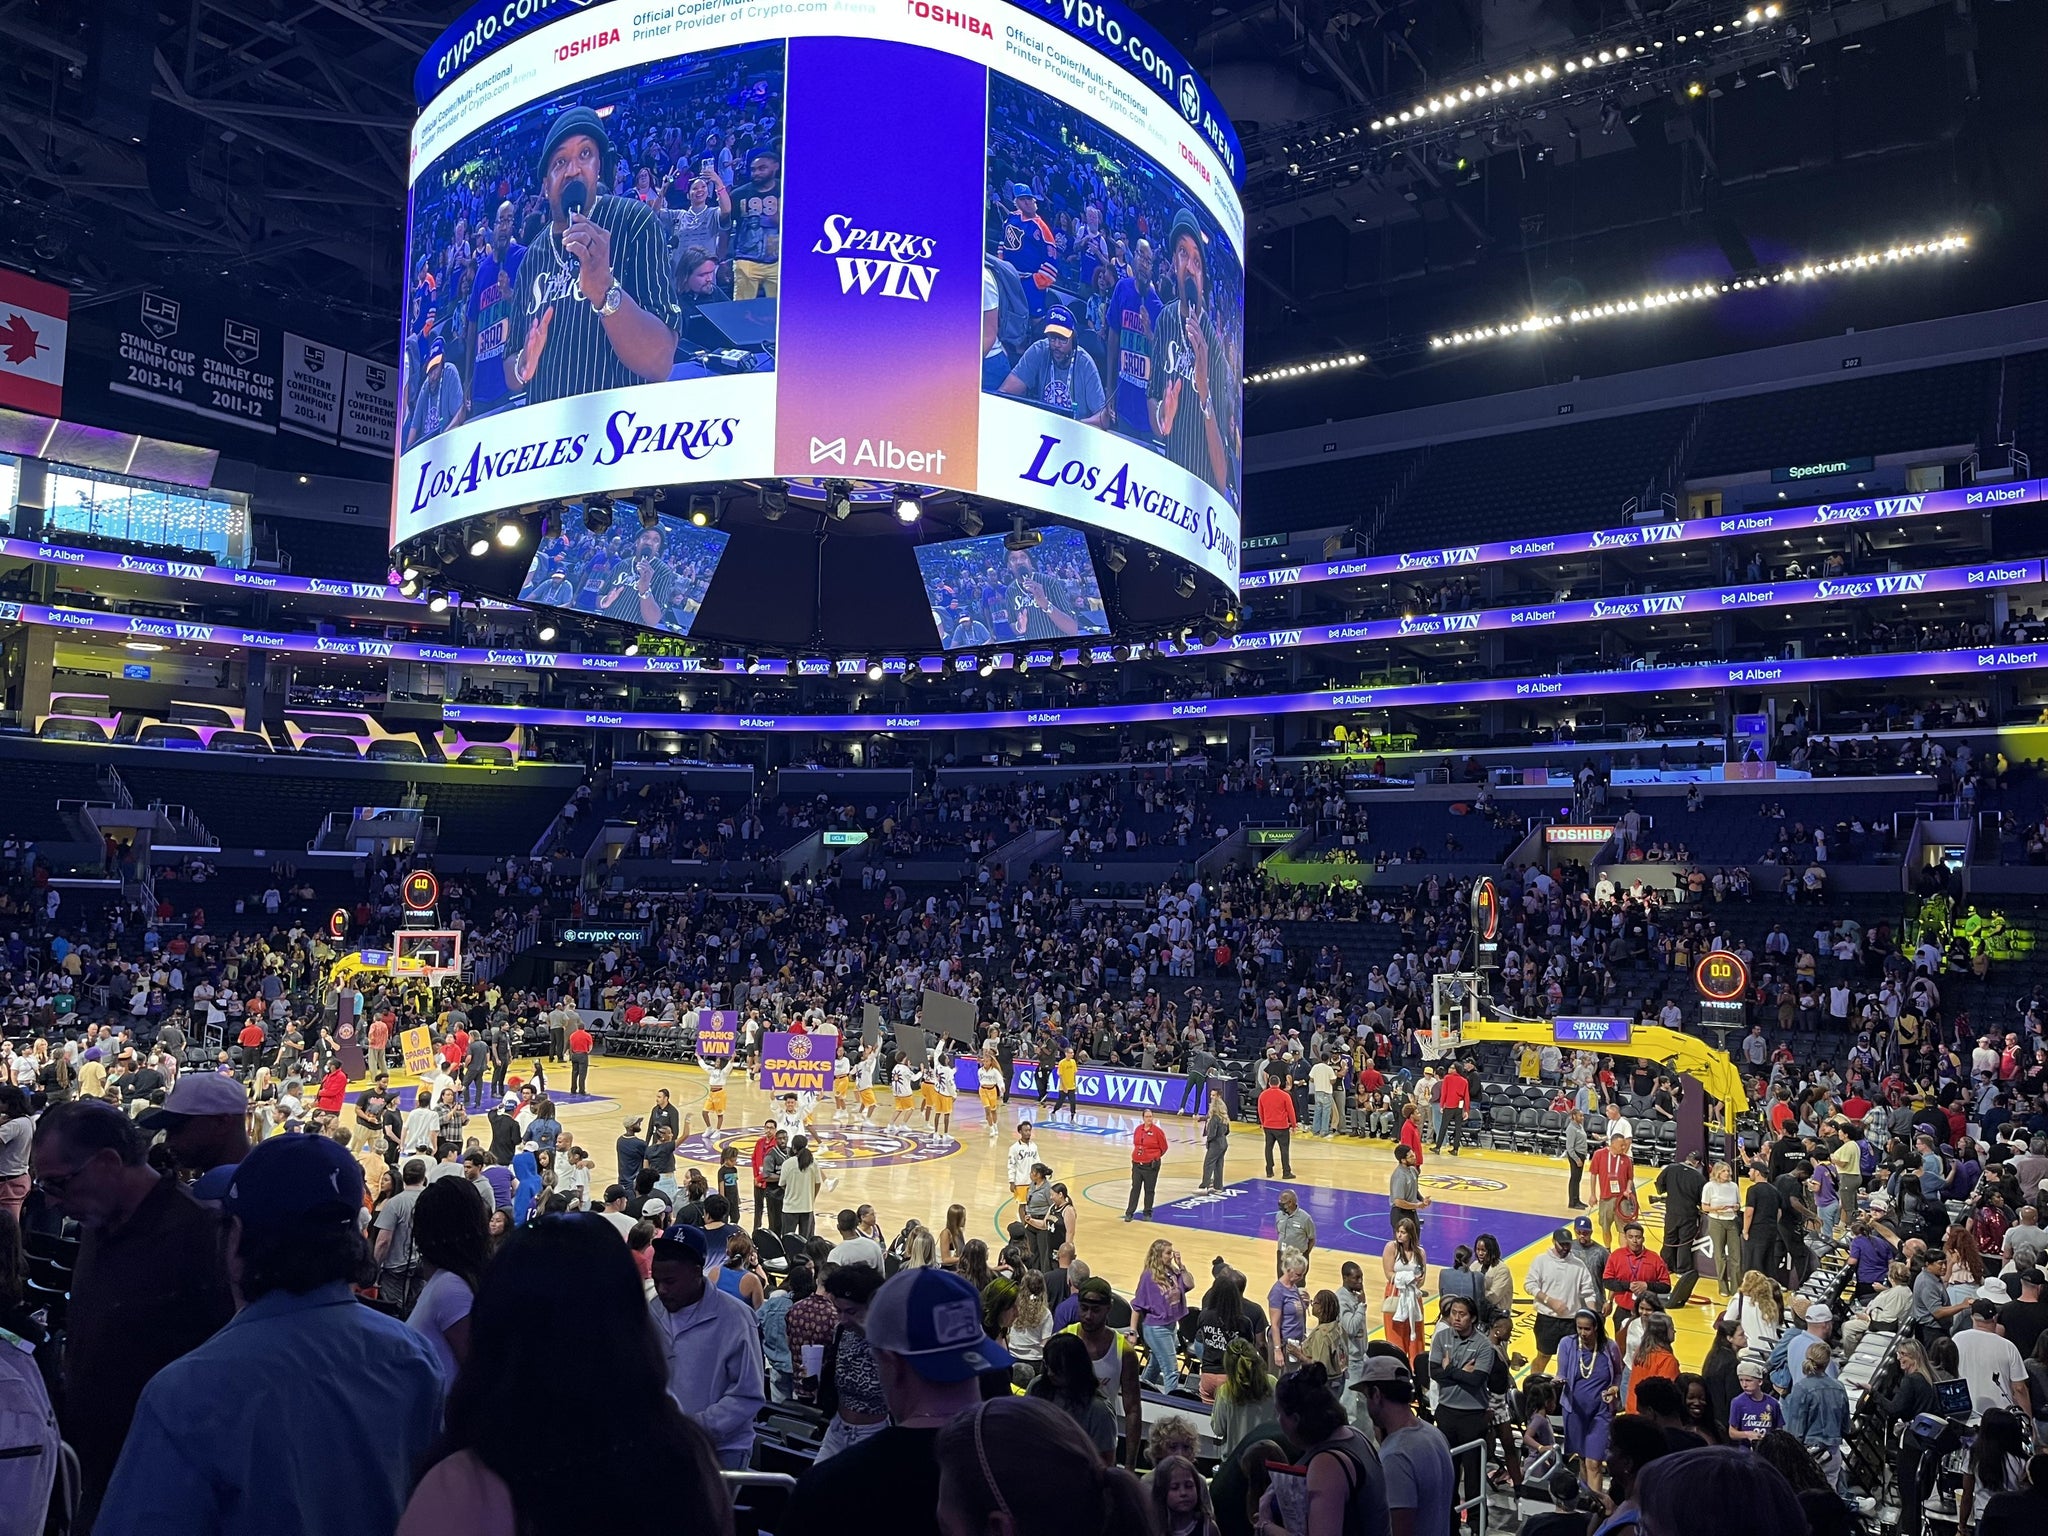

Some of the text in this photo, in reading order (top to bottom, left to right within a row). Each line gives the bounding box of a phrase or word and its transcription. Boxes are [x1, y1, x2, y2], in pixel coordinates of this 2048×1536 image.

[633, 4, 674, 26] Official
[633, 24, 672, 42] Printer
[675, 15, 726, 33] Provider
[730, 8, 743, 20] of
[747, 2, 828, 19] Crypto.com
[907, 0, 995, 40] TOSHIBA
[553, 28, 620, 64] TOSHIBA
[1006, 26, 1148, 116] Official Copier/Multi-Functional
[1006, 40, 1042, 66] Printer
[1045, 57, 1085, 89] Provider
[1087, 84, 1097, 95] of
[1099, 89, 1146, 130] Crypto.com
[460, 105, 468, 118] of
[468, 83, 510, 111] Crypto.com
[1203, 110, 1235, 177] ARENA
[1178, 141, 1211, 186] TOSHIBA
[812, 214, 937, 263] SPARKS
[835, 257, 940, 302] WIN
[119, 346, 195, 377] CHAMPIONS
[121, 332, 196, 363] STANLEY CUP
[128, 366, 183, 394] 2013-14
[202, 371, 274, 401] CHAMPIONS
[203, 358, 275, 387] STANLEY CUP
[294, 370, 331, 391] WESTERN
[212, 391, 263, 417] 2011-12
[287, 380, 337, 403] CONFERENCE
[289, 391, 333, 412] CHAMPIONS
[355, 390, 394, 409] WESTERN
[294, 404, 326, 424] 2013-14
[348, 400, 397, 419] CONFERENC
[356, 424, 390, 441] 2011-12
[410, 409, 741, 514] LOS ANGELES SPARKS
[853, 438, 946, 475] Albert
[1789, 461, 1847, 479] Spectrum
[1019, 434, 1237, 571] LOS ANGELES SPARKS
[1240, 487, 2026, 588] PARKS WIN Albert SPARKS WIN Albert SPARKS WIN Albert SPARKS WIN Albert
[1242, 536, 1279, 549] DELTA
[53, 549, 387, 599] Albert SPARKS WIN Albert SPARKS WIN
[1230, 567, 2027, 649] SPARKS WIN Albert SPARKS WIN Albert SPARKS WIN Albert SPARKS WIN Albert
[63, 611, 94, 625] Albert
[127, 617, 173, 635] SPARKS
[175, 623, 214, 640] WIN
[255, 634, 284, 646] Albert
[314, 637, 356, 654] SPARKS
[358, 641, 393, 656] WIN
[431, 649, 458, 660] Albert
[484, 650, 523, 666] SPARKS
[525, 653, 557, 666] WIN
[593, 658, 618, 668] Albert
[644, 657, 680, 671] SPARKS
[682, 659, 702, 671] WI
[597, 715, 622, 725] Albert
[751, 719, 775, 728] Albert
[897, 718, 921, 727] Albert
[1038, 713, 1060, 722] Albert
[1183, 705, 1207, 715] Albert
[1345, 694, 1372, 705] Albert
[1531, 682, 1562, 694] Albert
[1745, 668, 1782, 680] Albert
[1997, 651, 2038, 665] Albert
[1548, 829, 1613, 840] TOSHIBA
[577, 930, 643, 941] cryptocom
[1711, 964, 1730, 977] 0.0
[1711, 1001, 1743, 1009] TISSOT
[699, 1031, 734, 1041] SPARKS
[1572, 1022, 1609, 1031] SPARKS
[1577, 1030, 1604, 1041] WIN
[405, 1046, 431, 1060] SPARKS
[702, 1041, 730, 1054] WIN
[410, 1059, 431, 1073] WIN
[764, 1059, 832, 1071] SPARKS
[772, 1072, 824, 1088] WIN
[1104, 1074, 1168, 1106] WIN
